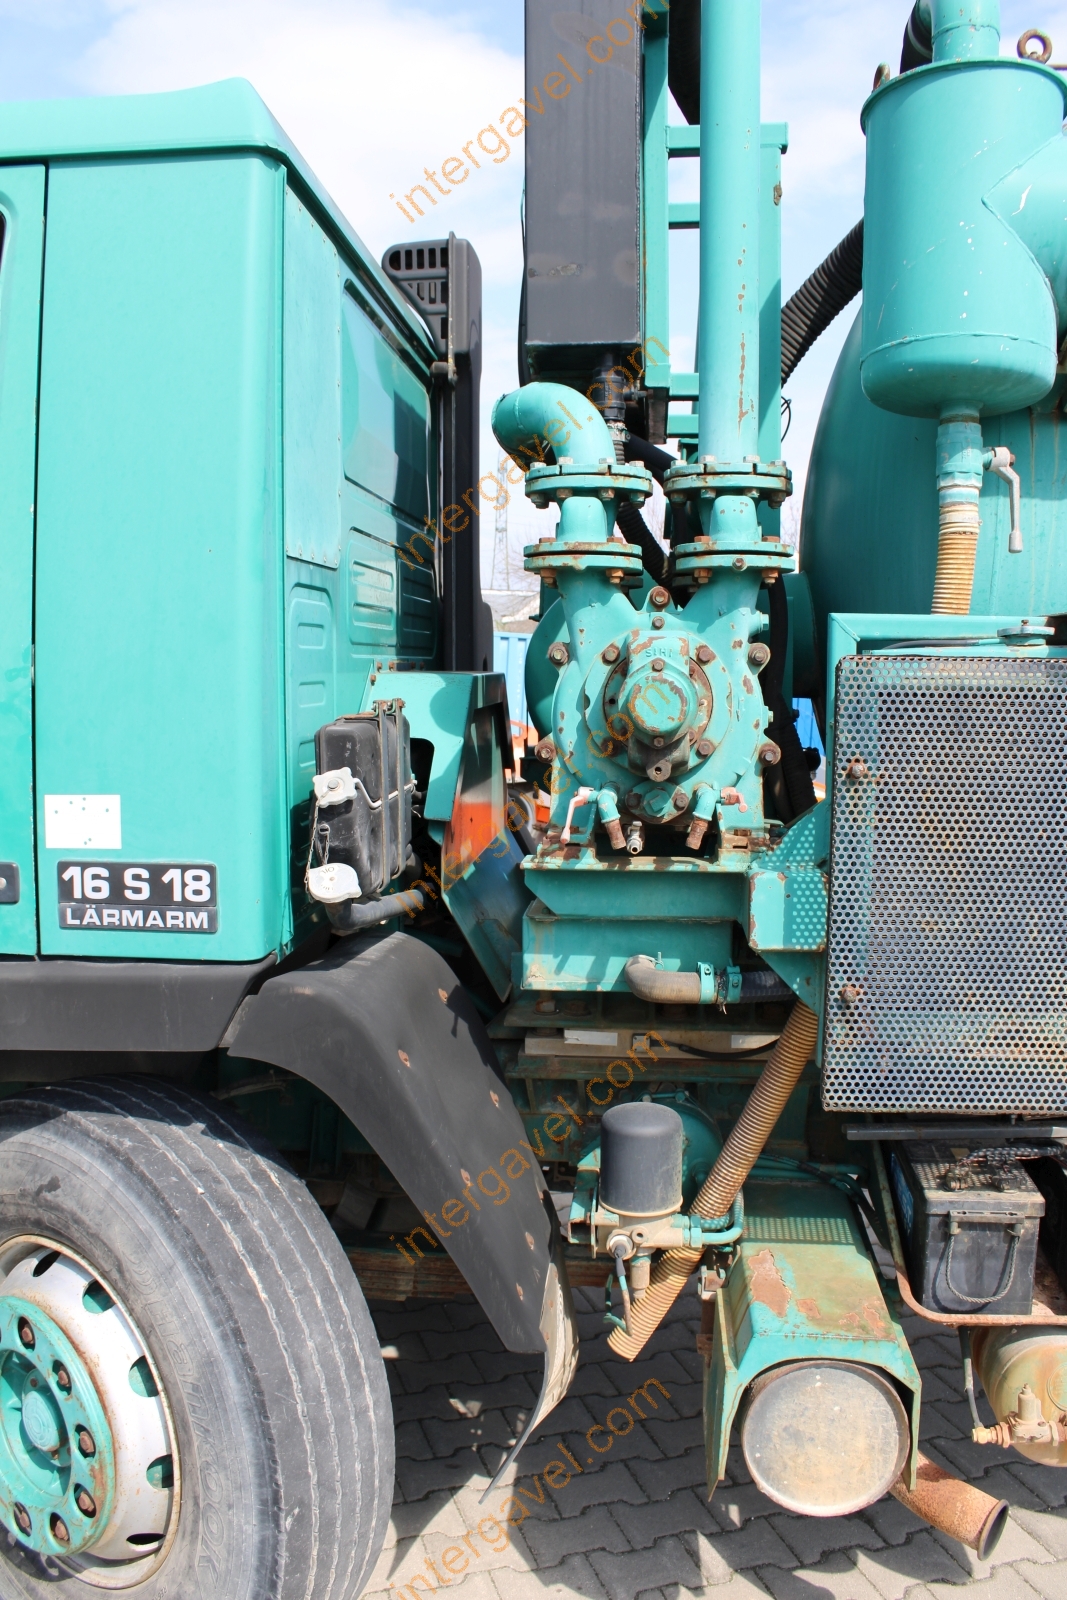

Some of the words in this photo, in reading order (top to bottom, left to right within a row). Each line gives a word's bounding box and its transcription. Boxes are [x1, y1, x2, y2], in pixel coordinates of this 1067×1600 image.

[646, 647, 673, 658] SIHI
[61, 866, 110, 900] 16
[123, 867, 150, 901] S
[161, 868, 211, 902] 18
[66, 904, 209, 929] LÄRMARM
